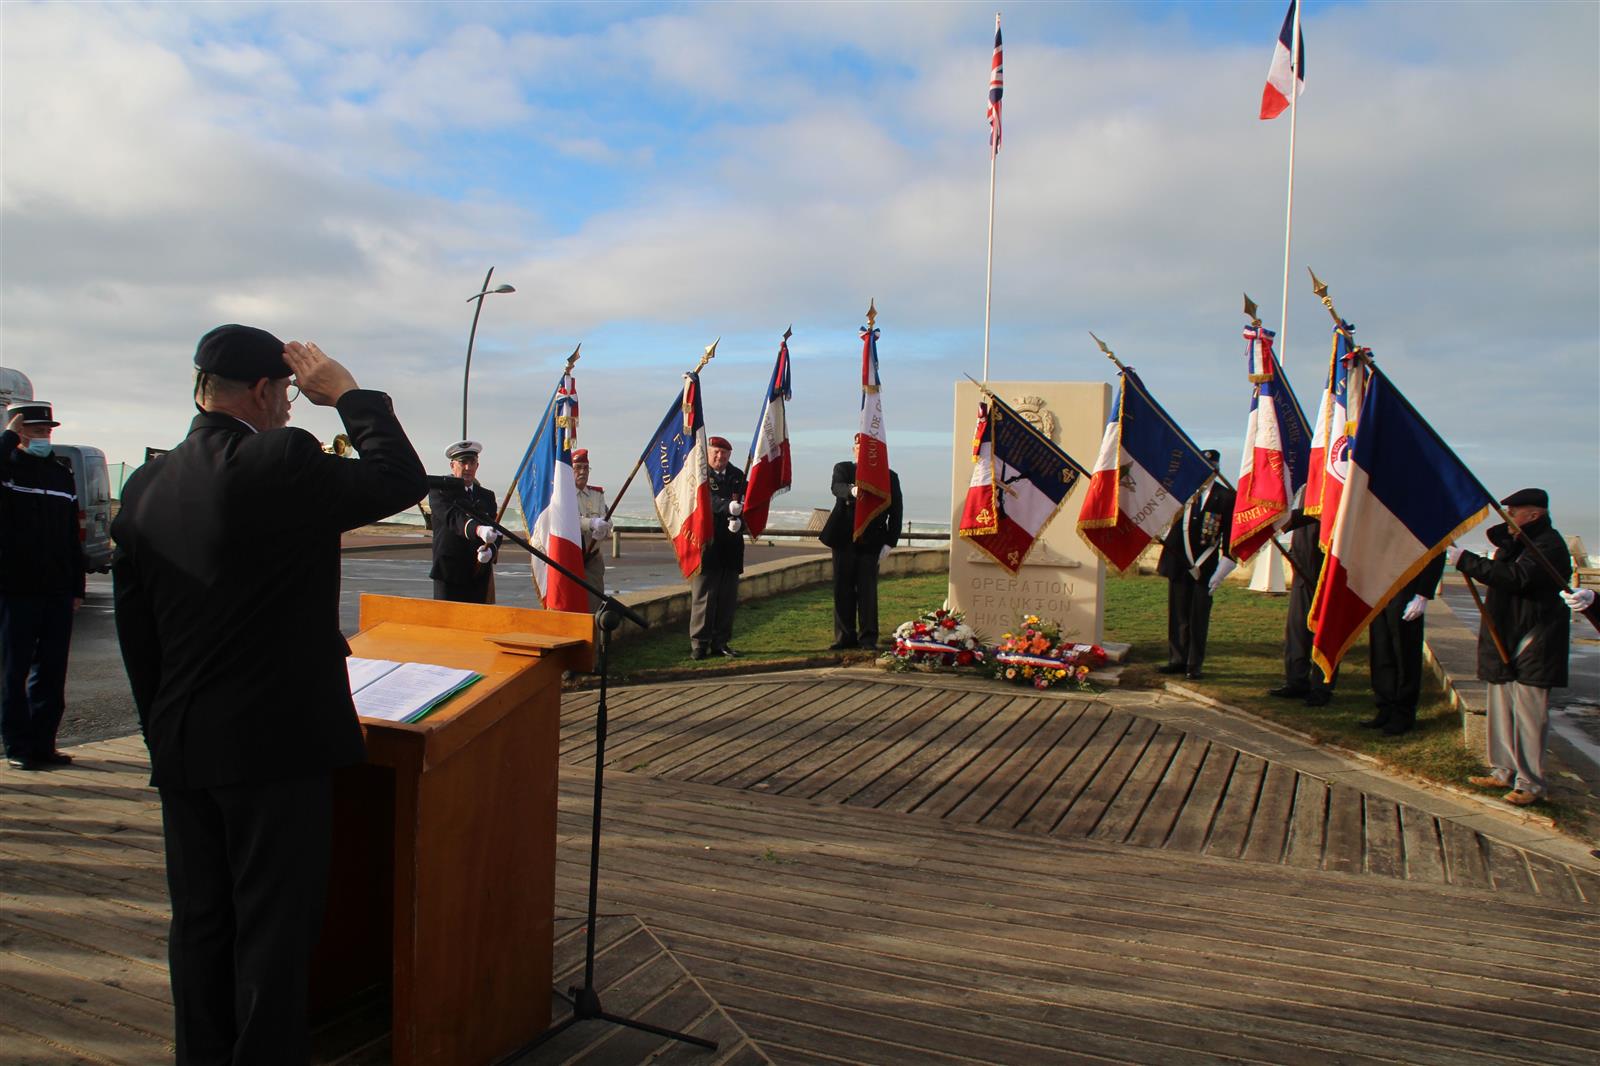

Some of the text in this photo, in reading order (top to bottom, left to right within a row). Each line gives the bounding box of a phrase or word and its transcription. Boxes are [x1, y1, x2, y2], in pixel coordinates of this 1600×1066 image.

[871, 414, 881, 430] DE
[970, 577, 1075, 596] OPERATION
[971, 594, 1072, 613] FRANKTON
